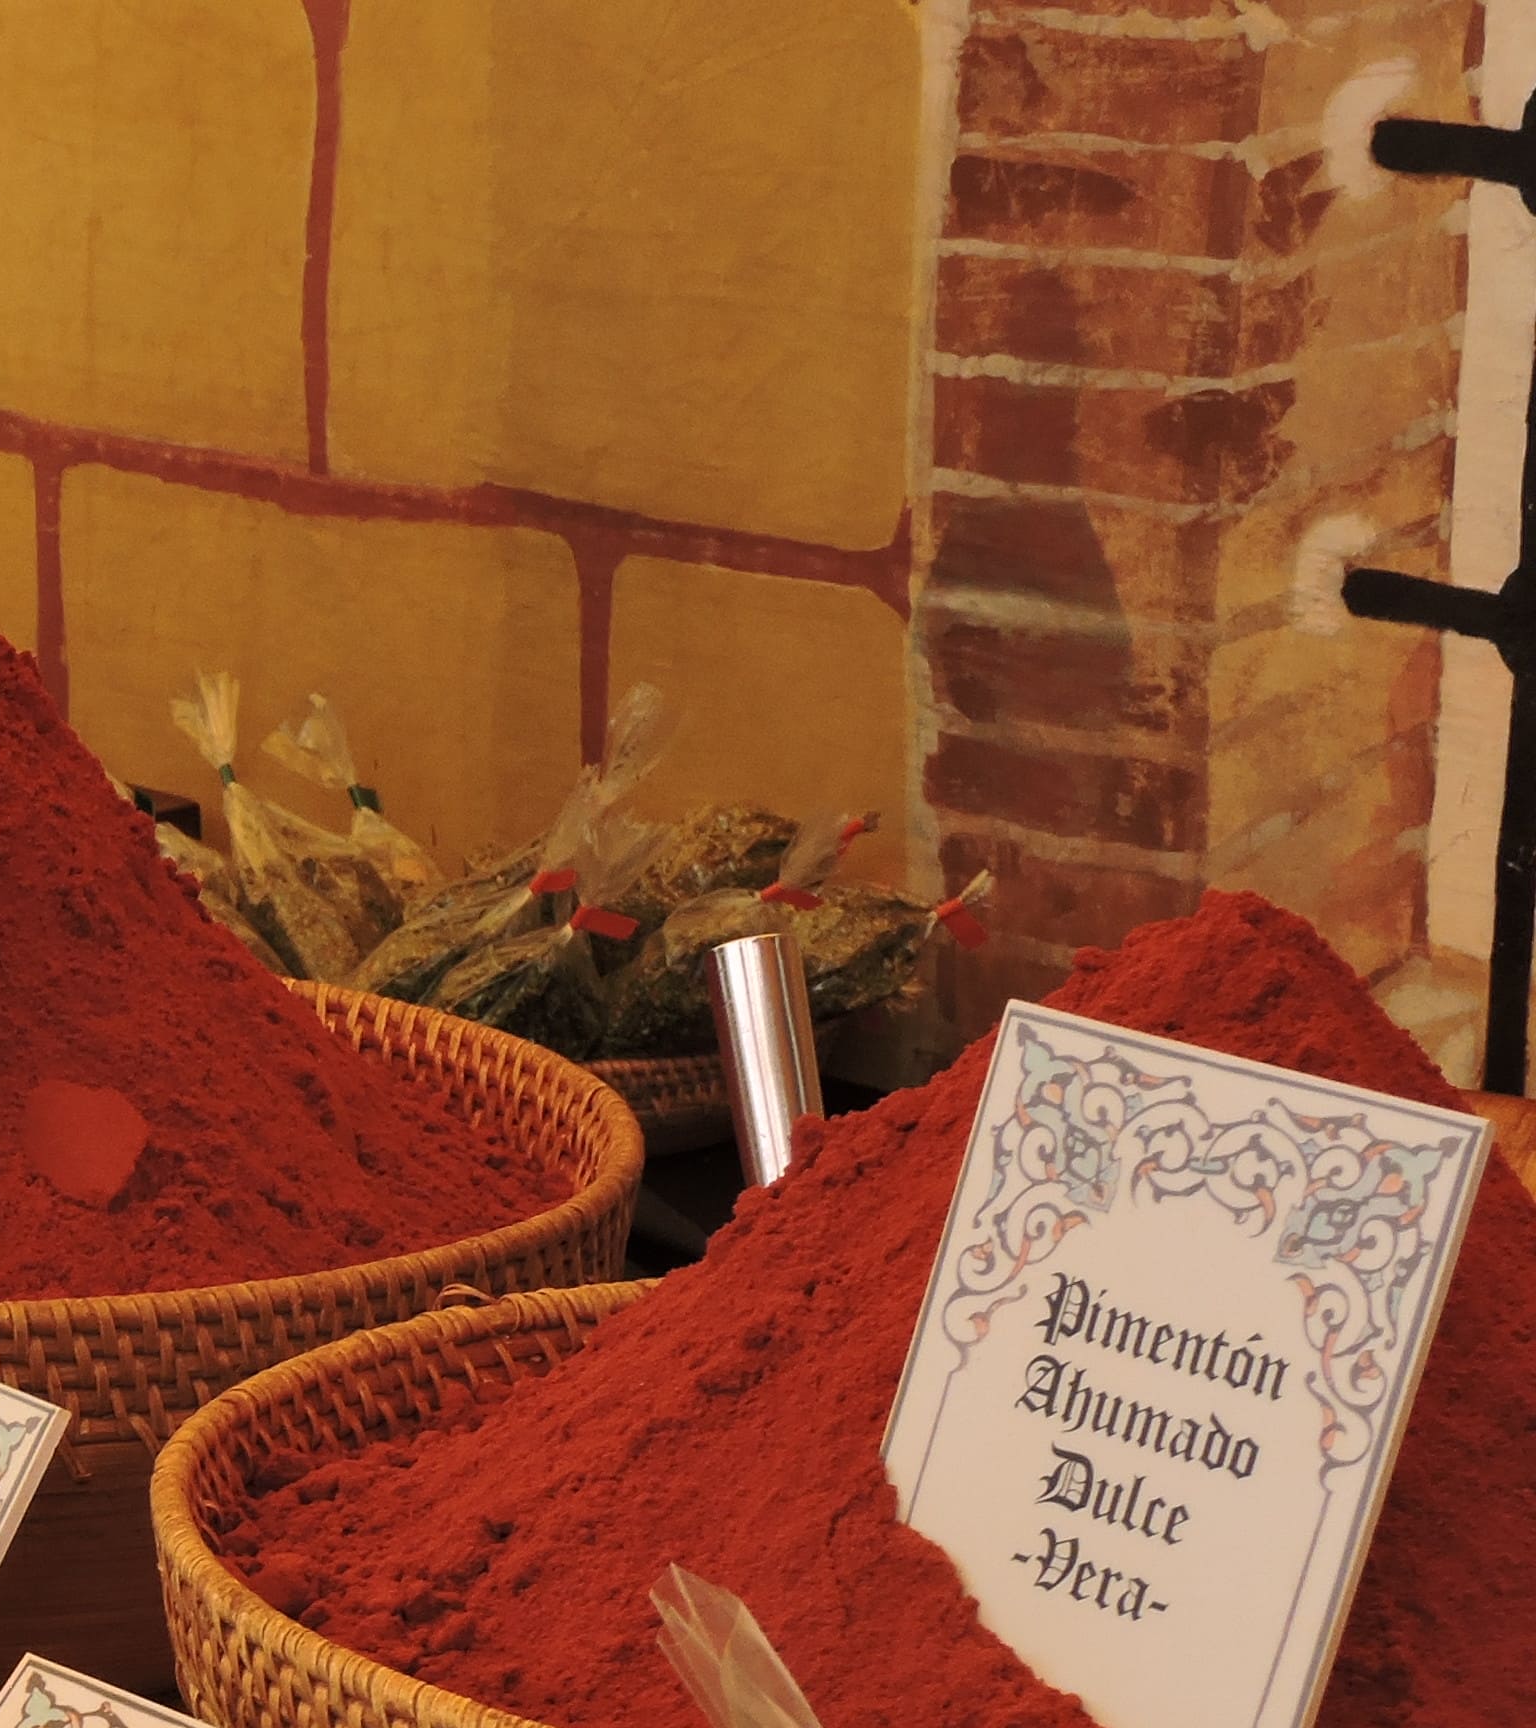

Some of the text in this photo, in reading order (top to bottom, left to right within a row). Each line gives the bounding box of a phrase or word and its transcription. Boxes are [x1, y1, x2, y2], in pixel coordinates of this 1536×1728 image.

[1034, 1271, 1293, 1402] Pimentón
[1013, 1353, 1261, 1482] Ahumado
[1036, 1440, 1191, 1547] Dulce
[1009, 1528, 1172, 1625] -Vera-
